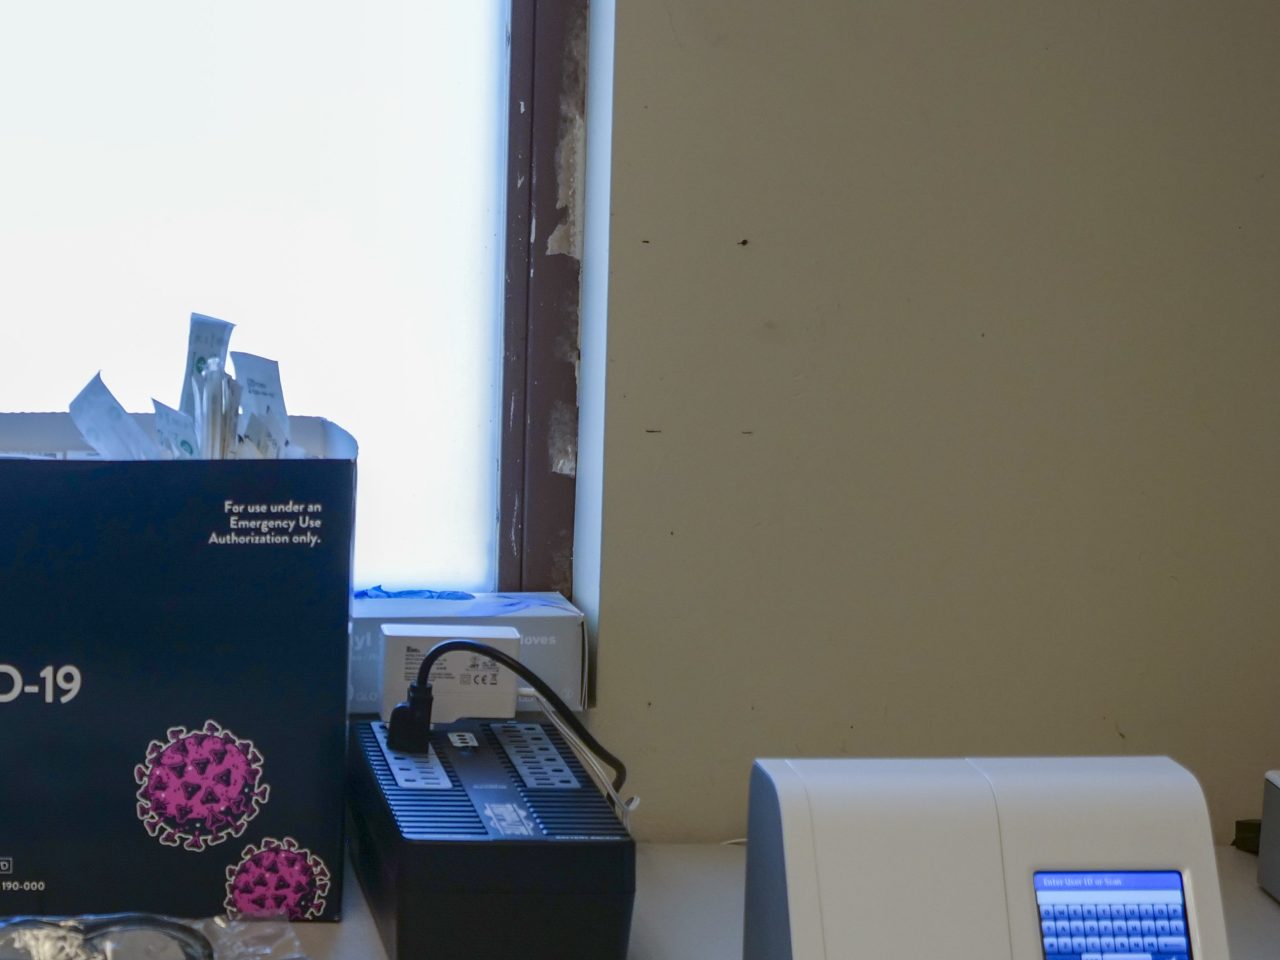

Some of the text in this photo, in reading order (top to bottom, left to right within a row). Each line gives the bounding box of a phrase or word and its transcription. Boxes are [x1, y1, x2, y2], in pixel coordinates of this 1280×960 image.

[224, 499, 322, 513] For use under an
[229, 515, 322, 533] Emergency Use
[208, 531, 322, 548] Authorization only.
[519, 633, 557, 646] loves
[1, 881, 46, 891] 190-000
